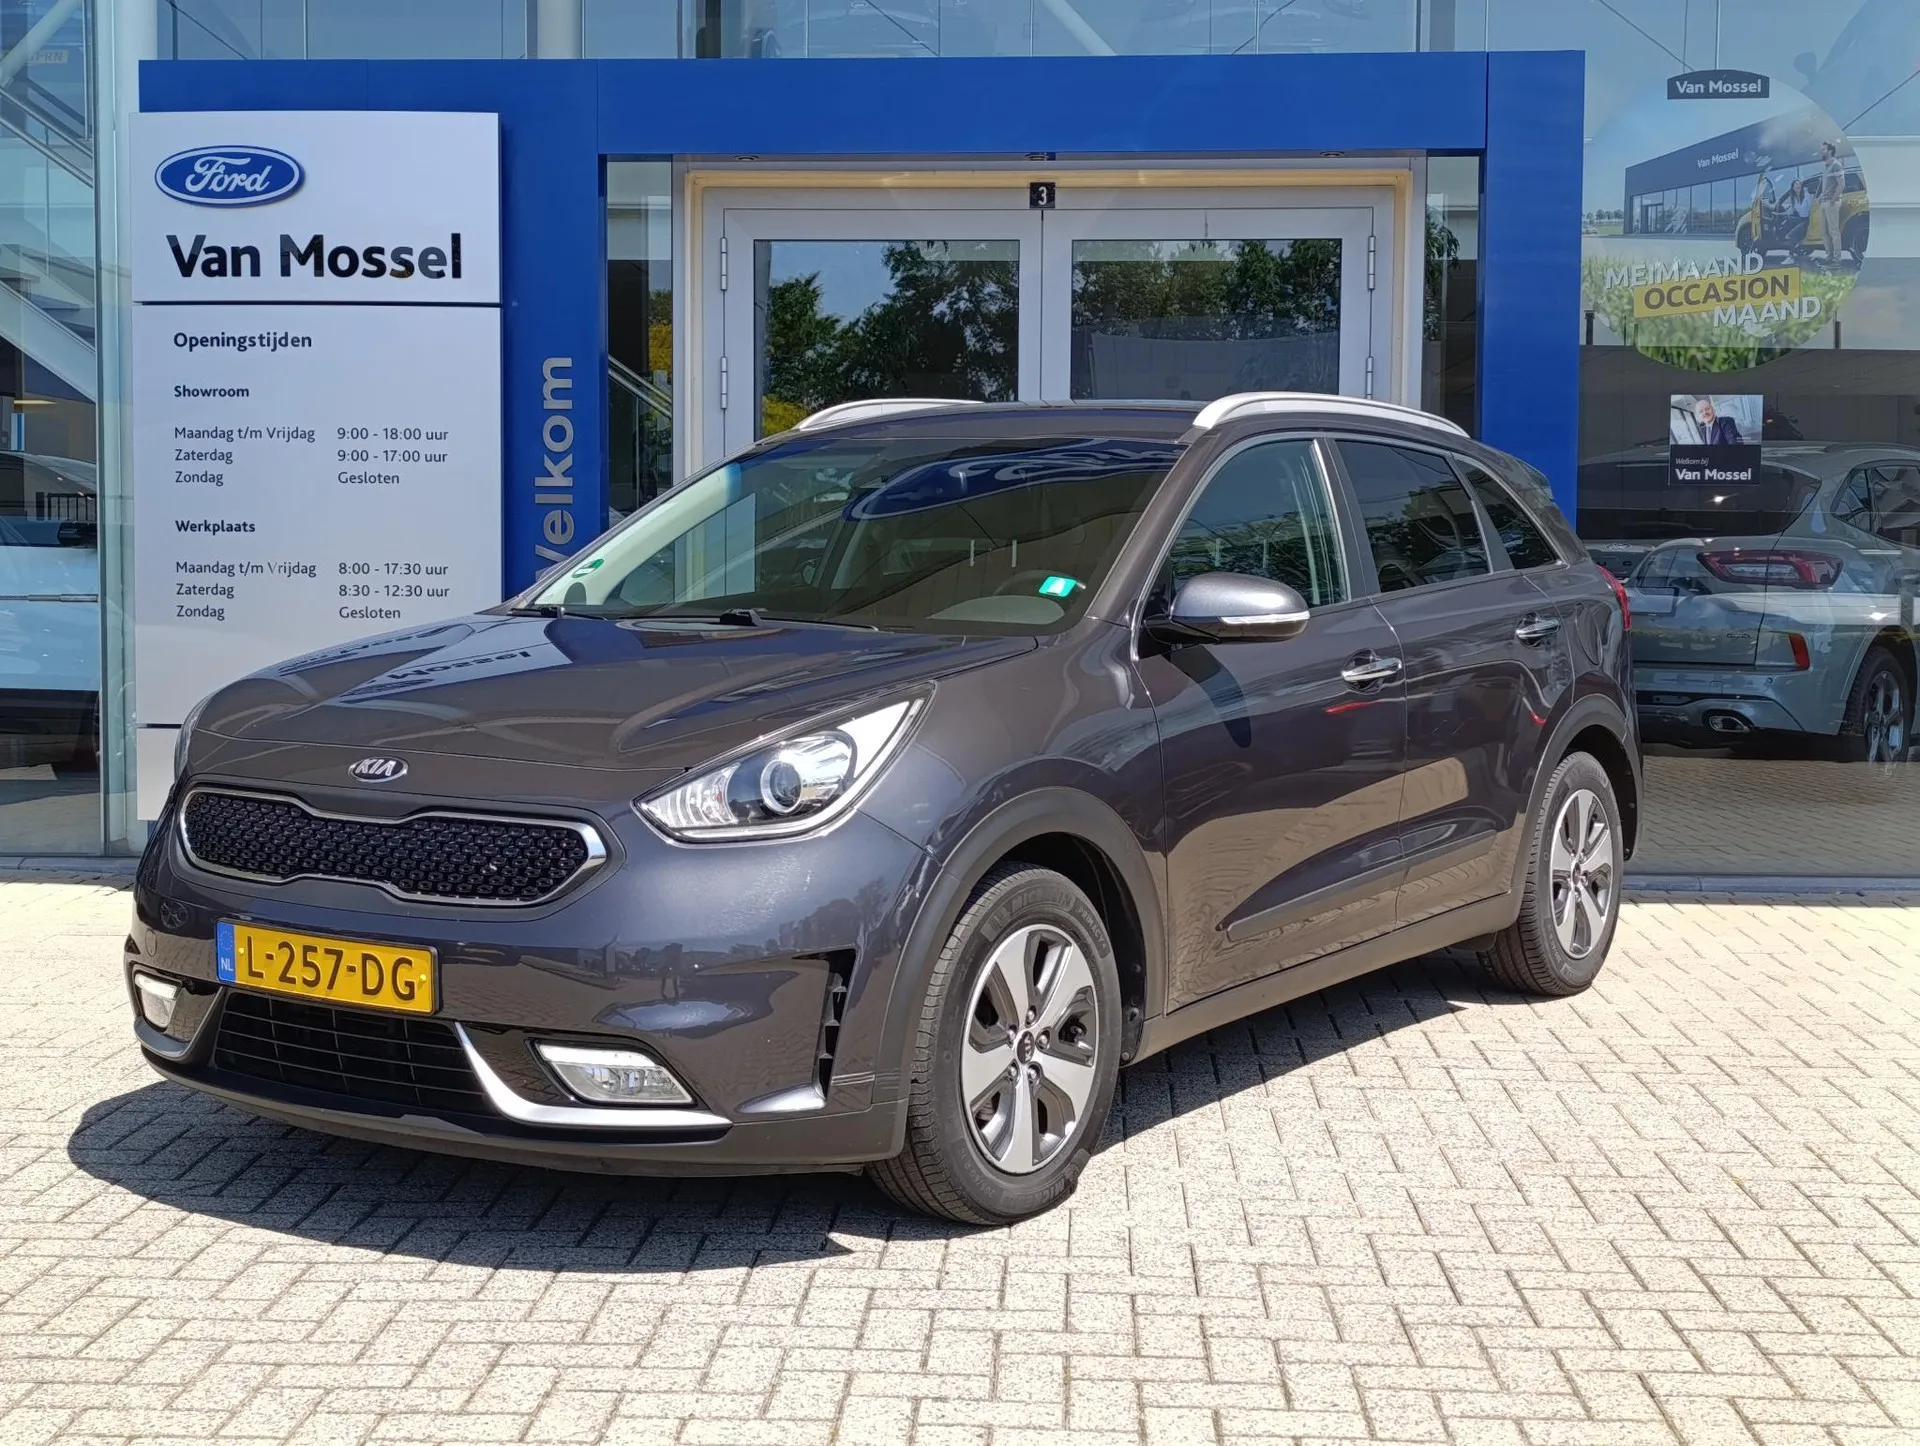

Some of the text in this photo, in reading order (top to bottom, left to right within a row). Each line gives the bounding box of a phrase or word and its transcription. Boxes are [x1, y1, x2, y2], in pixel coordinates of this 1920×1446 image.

[1676, 79, 1761, 94] Van Mossel
[1697, 148, 1739, 168] Van Mossel
[185, 156, 272, 193] Ford
[1038, 186, 1047, 206] 3
[165, 232, 462, 279] Van Mossel
[1644, 275, 1789, 310] OCCASION
[1713, 296, 1822, 328] MAAND
[173, 331, 312, 352] Openingstijden
[174, 384, 250, 397] Showroom
[174, 425, 235, 442] Maandag
[237, 426, 263, 439] t/m
[266, 426, 316, 443] Vrijdag
[337, 427, 369, 439] 9:00
[383, 427, 422, 440] 18:00
[425, 431, 449, 440] uur
[174, 448, 234, 464] Zaterdag
[337, 449, 369, 461] 9:00
[382, 449, 421, 462] 17:00
[424, 453, 448, 462] uur
[175, 470, 400, 486] Zondag Gesloten
[1675, 468, 1752, 480] Van Mossel
[174, 519, 256, 535] Werkplaats
[175, 560, 236, 577] Maandag
[238, 561, 264, 576] t/m
[267, 561, 317, 578] Vrijdag
[338, 562, 371, 574] 8:00
[384, 562, 422, 575] 17:30
[425, 566, 449, 575] uur
[176, 582, 235, 599] Zaterdag
[338, 584, 370, 596] 8:30
[384, 584, 423, 596] 12:30
[426, 588, 450, 597] uur
[176, 604, 401, 621] Zondag Gesloten
[355, 758, 394, 777] KIA
[221, 935, 415, 1001] NL L-257-DG
